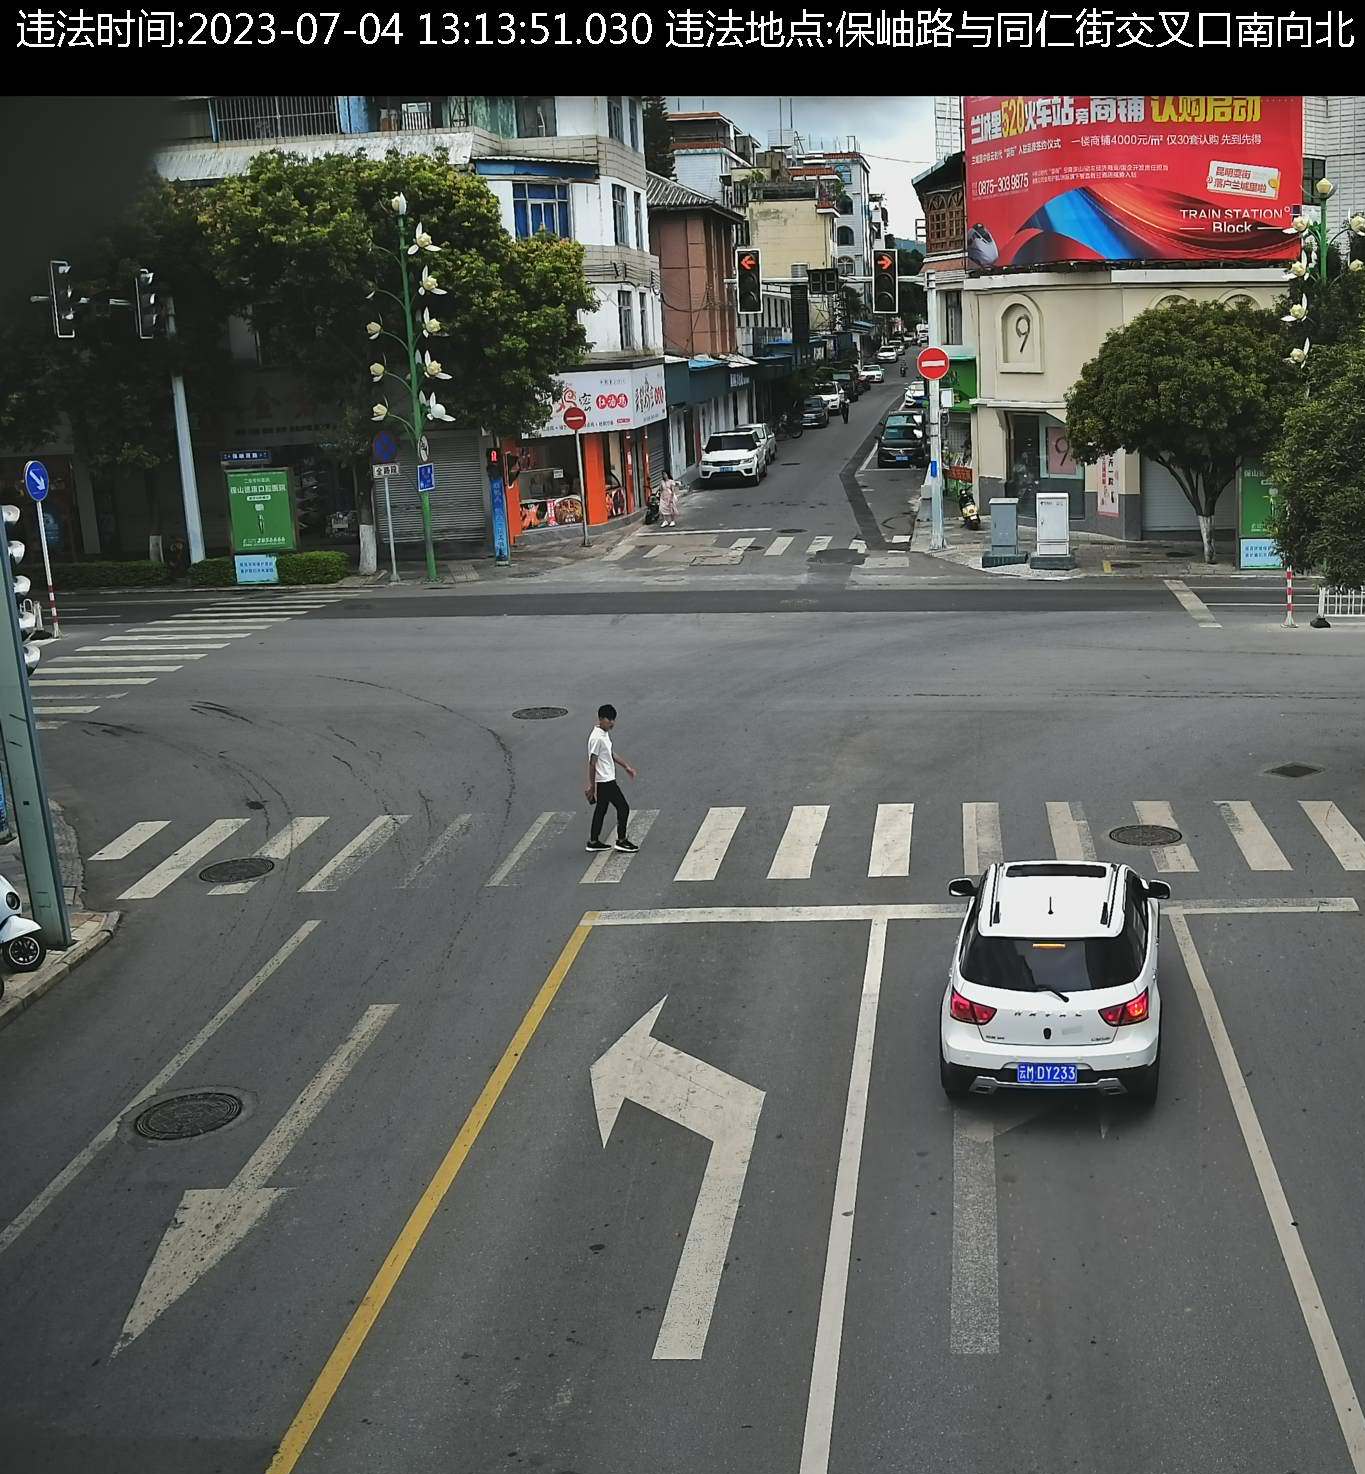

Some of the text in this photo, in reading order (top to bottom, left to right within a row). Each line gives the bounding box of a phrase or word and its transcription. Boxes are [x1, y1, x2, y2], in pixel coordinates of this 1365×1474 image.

[1151, 96, 1263, 123] 认购启动
[1221, 134, 1263, 146] 先到先得
[1180, 208, 1283, 220] TRAIN STATION
[1212, 221, 1252, 233] Block
